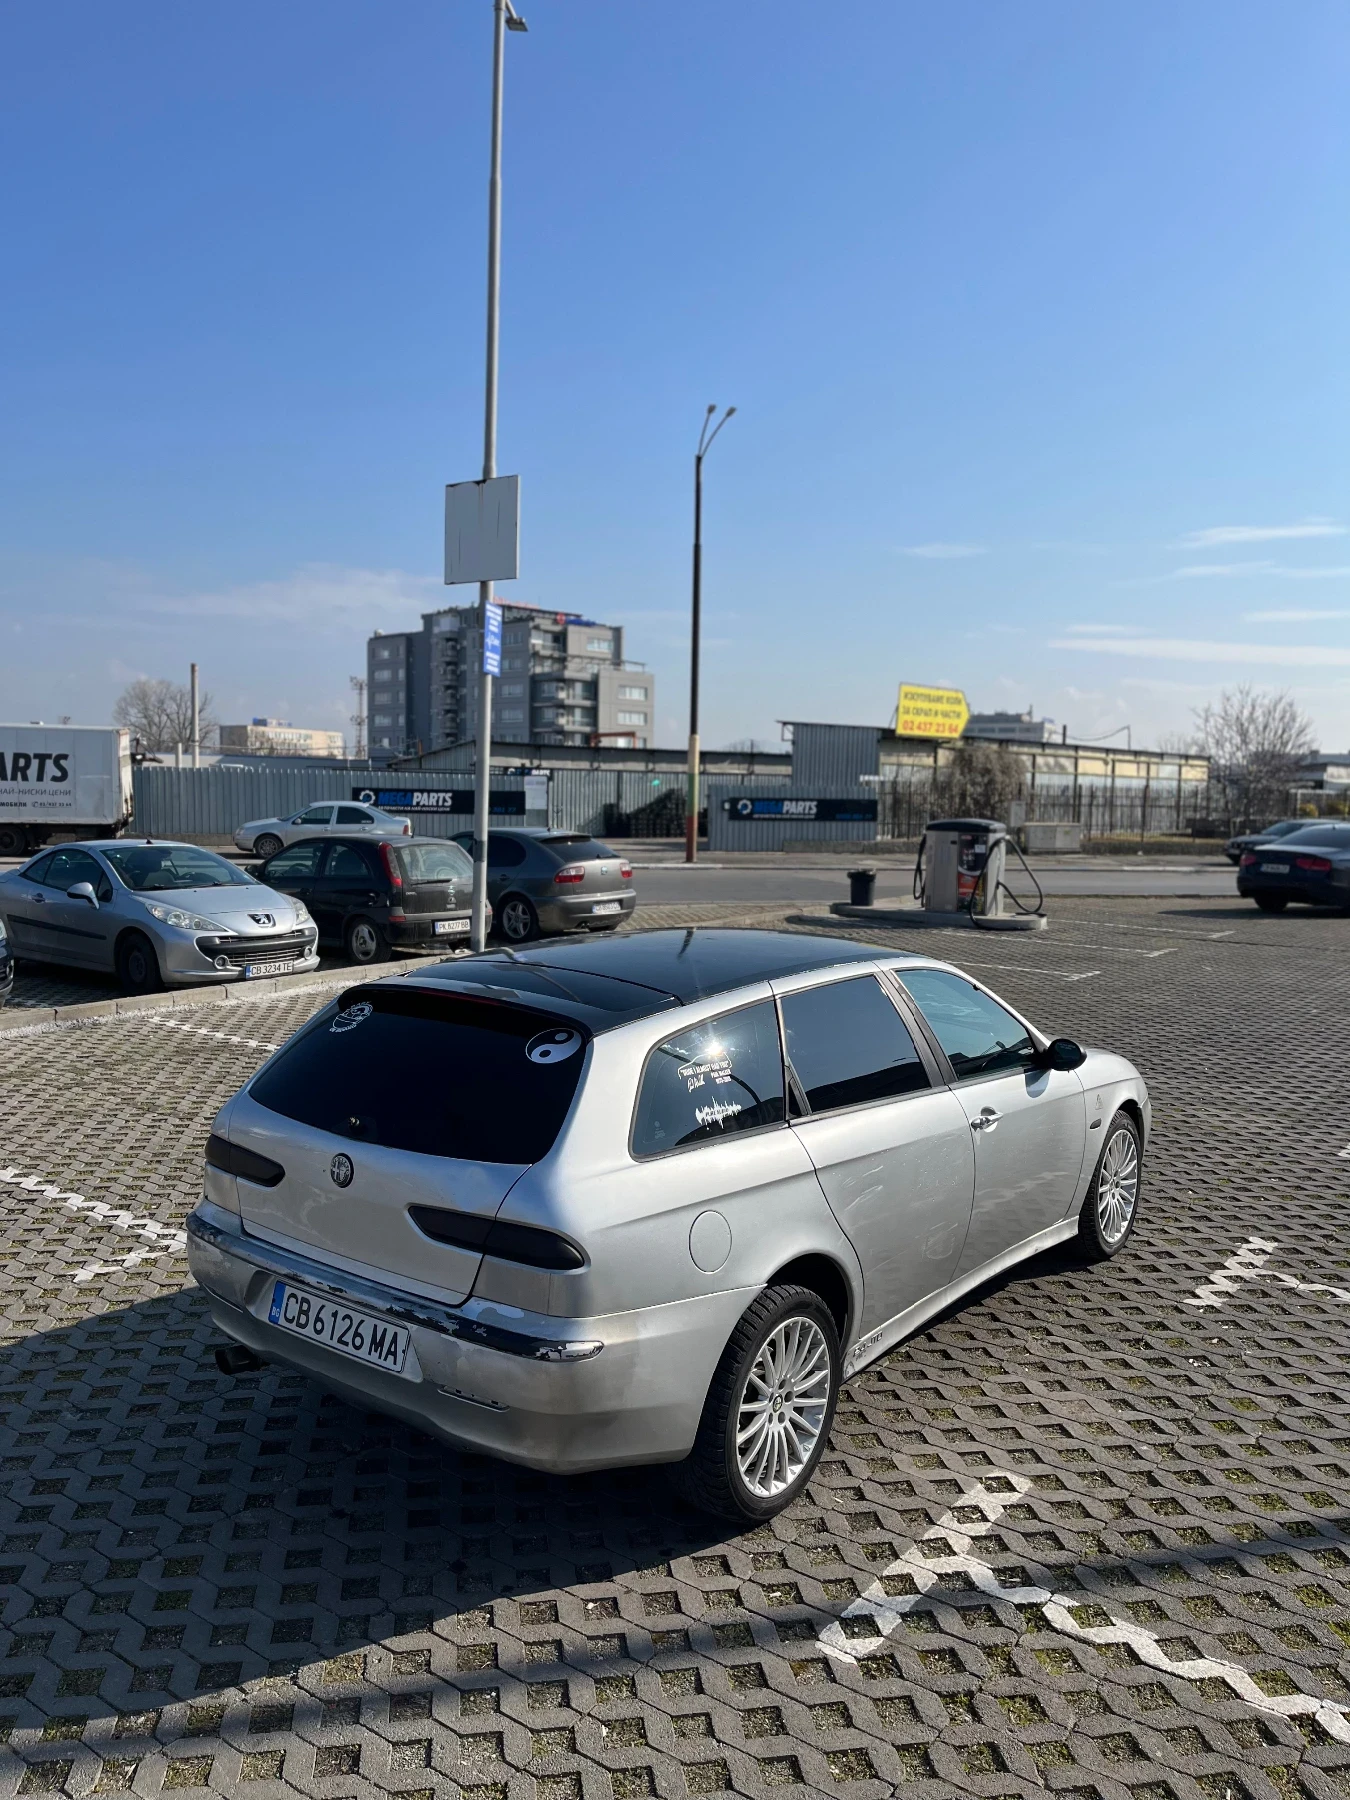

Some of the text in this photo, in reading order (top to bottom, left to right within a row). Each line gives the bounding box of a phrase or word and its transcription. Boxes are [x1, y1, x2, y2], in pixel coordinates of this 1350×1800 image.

[48, 789, 71, 797] ЦЕНИ
[378, 791, 453, 807] MEGAPARTS
[753, 801, 818, 815] MEGAPARTS
[251, 962, 292, 975] CB 3234 TE
